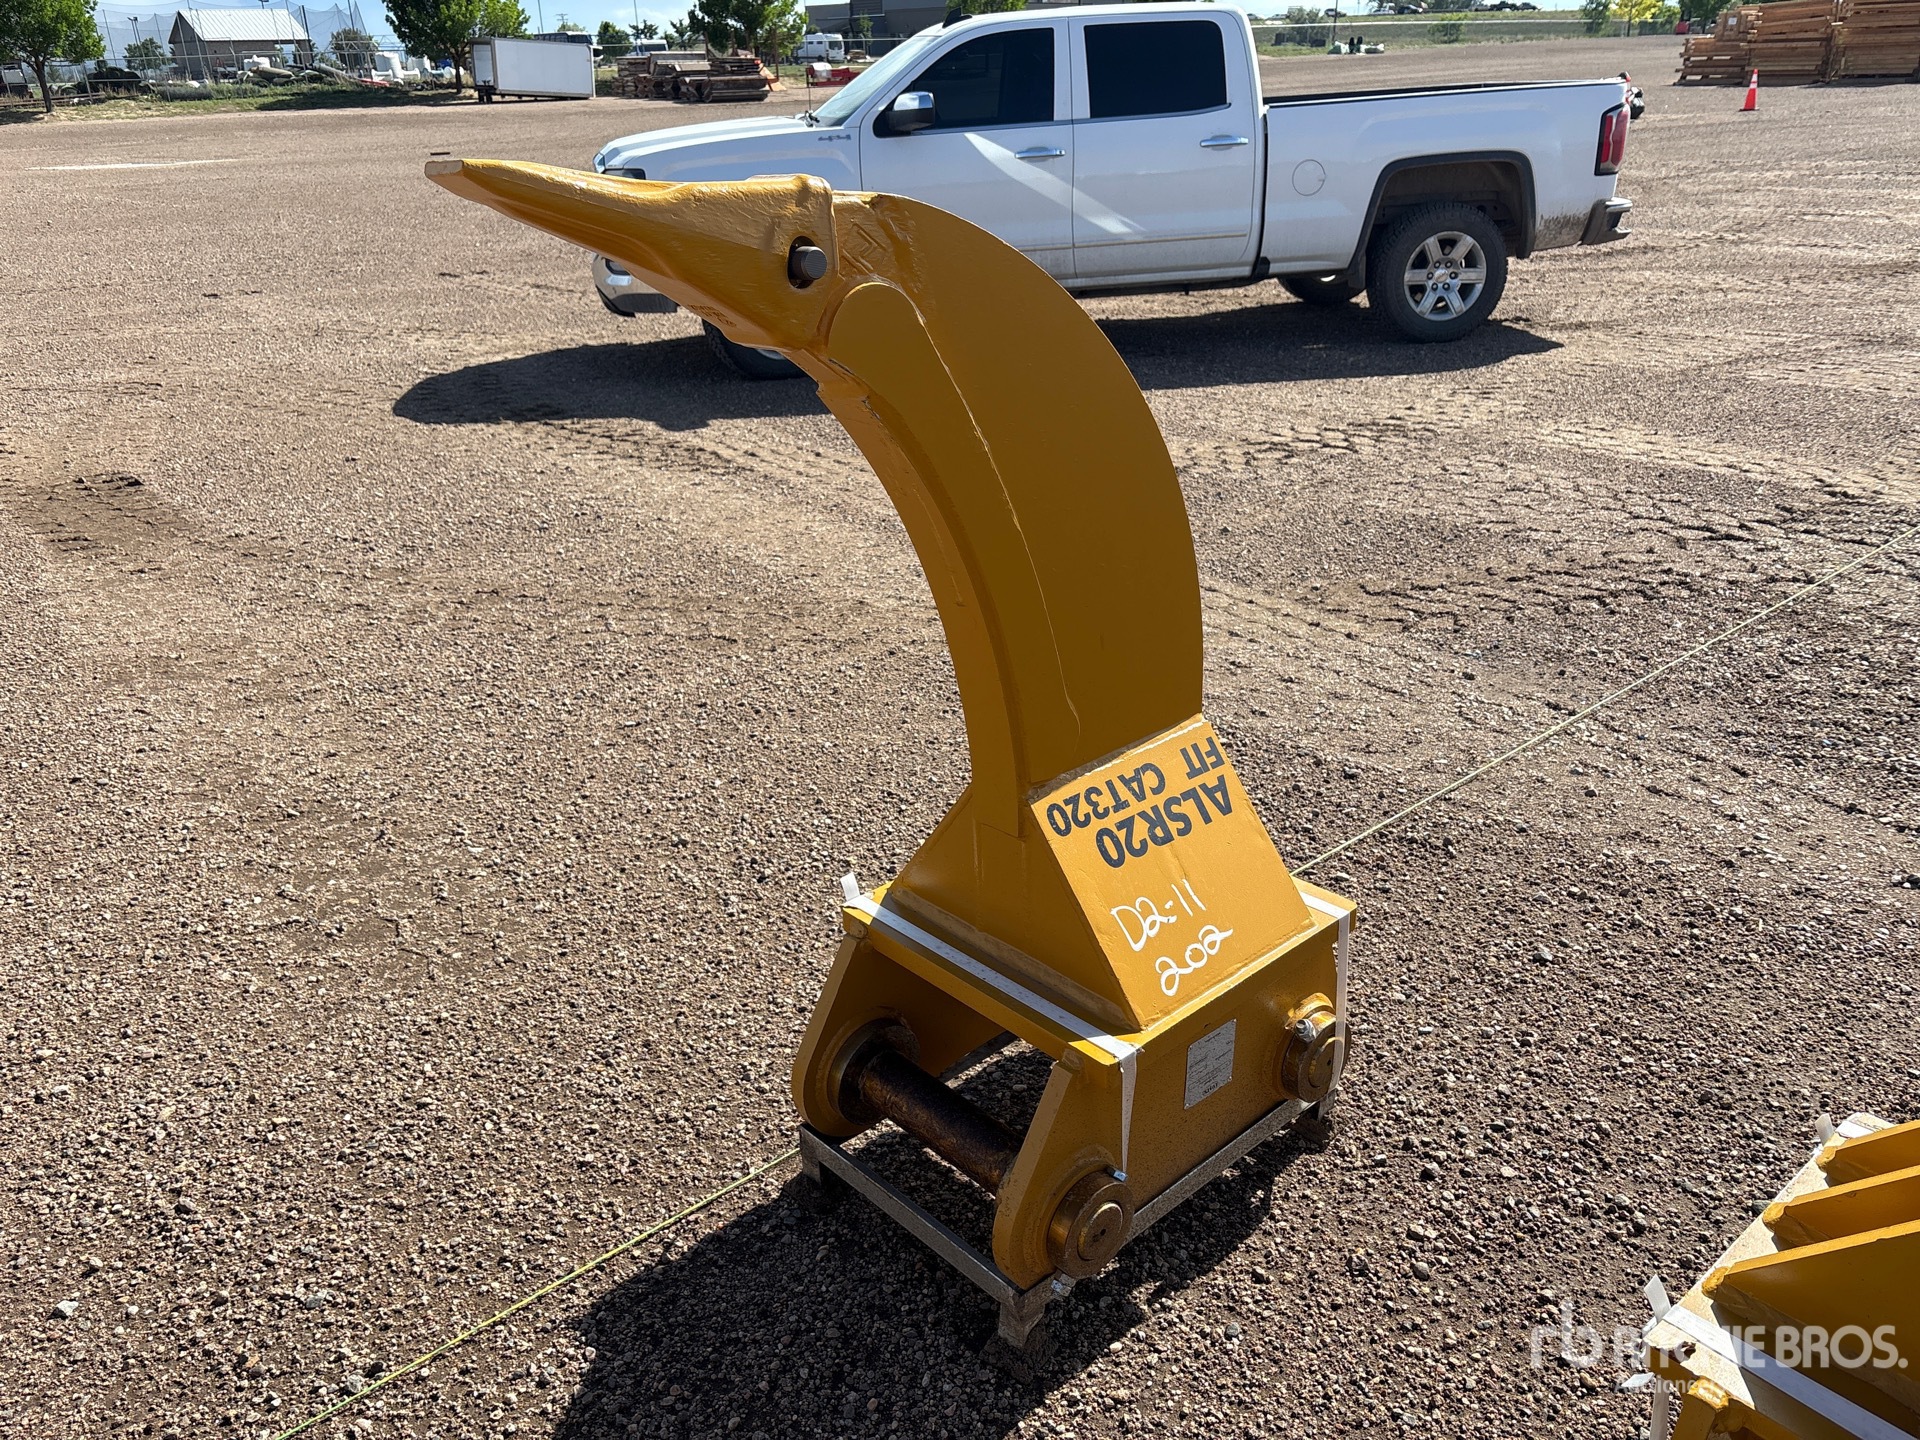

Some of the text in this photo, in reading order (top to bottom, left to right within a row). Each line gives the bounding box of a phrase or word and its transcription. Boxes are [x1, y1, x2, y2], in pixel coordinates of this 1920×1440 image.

[1046, 736, 1226, 837] FIT CAT320
[1095, 774, 1234, 868] ALSR20
[1155, 924, 1234, 997] 202
